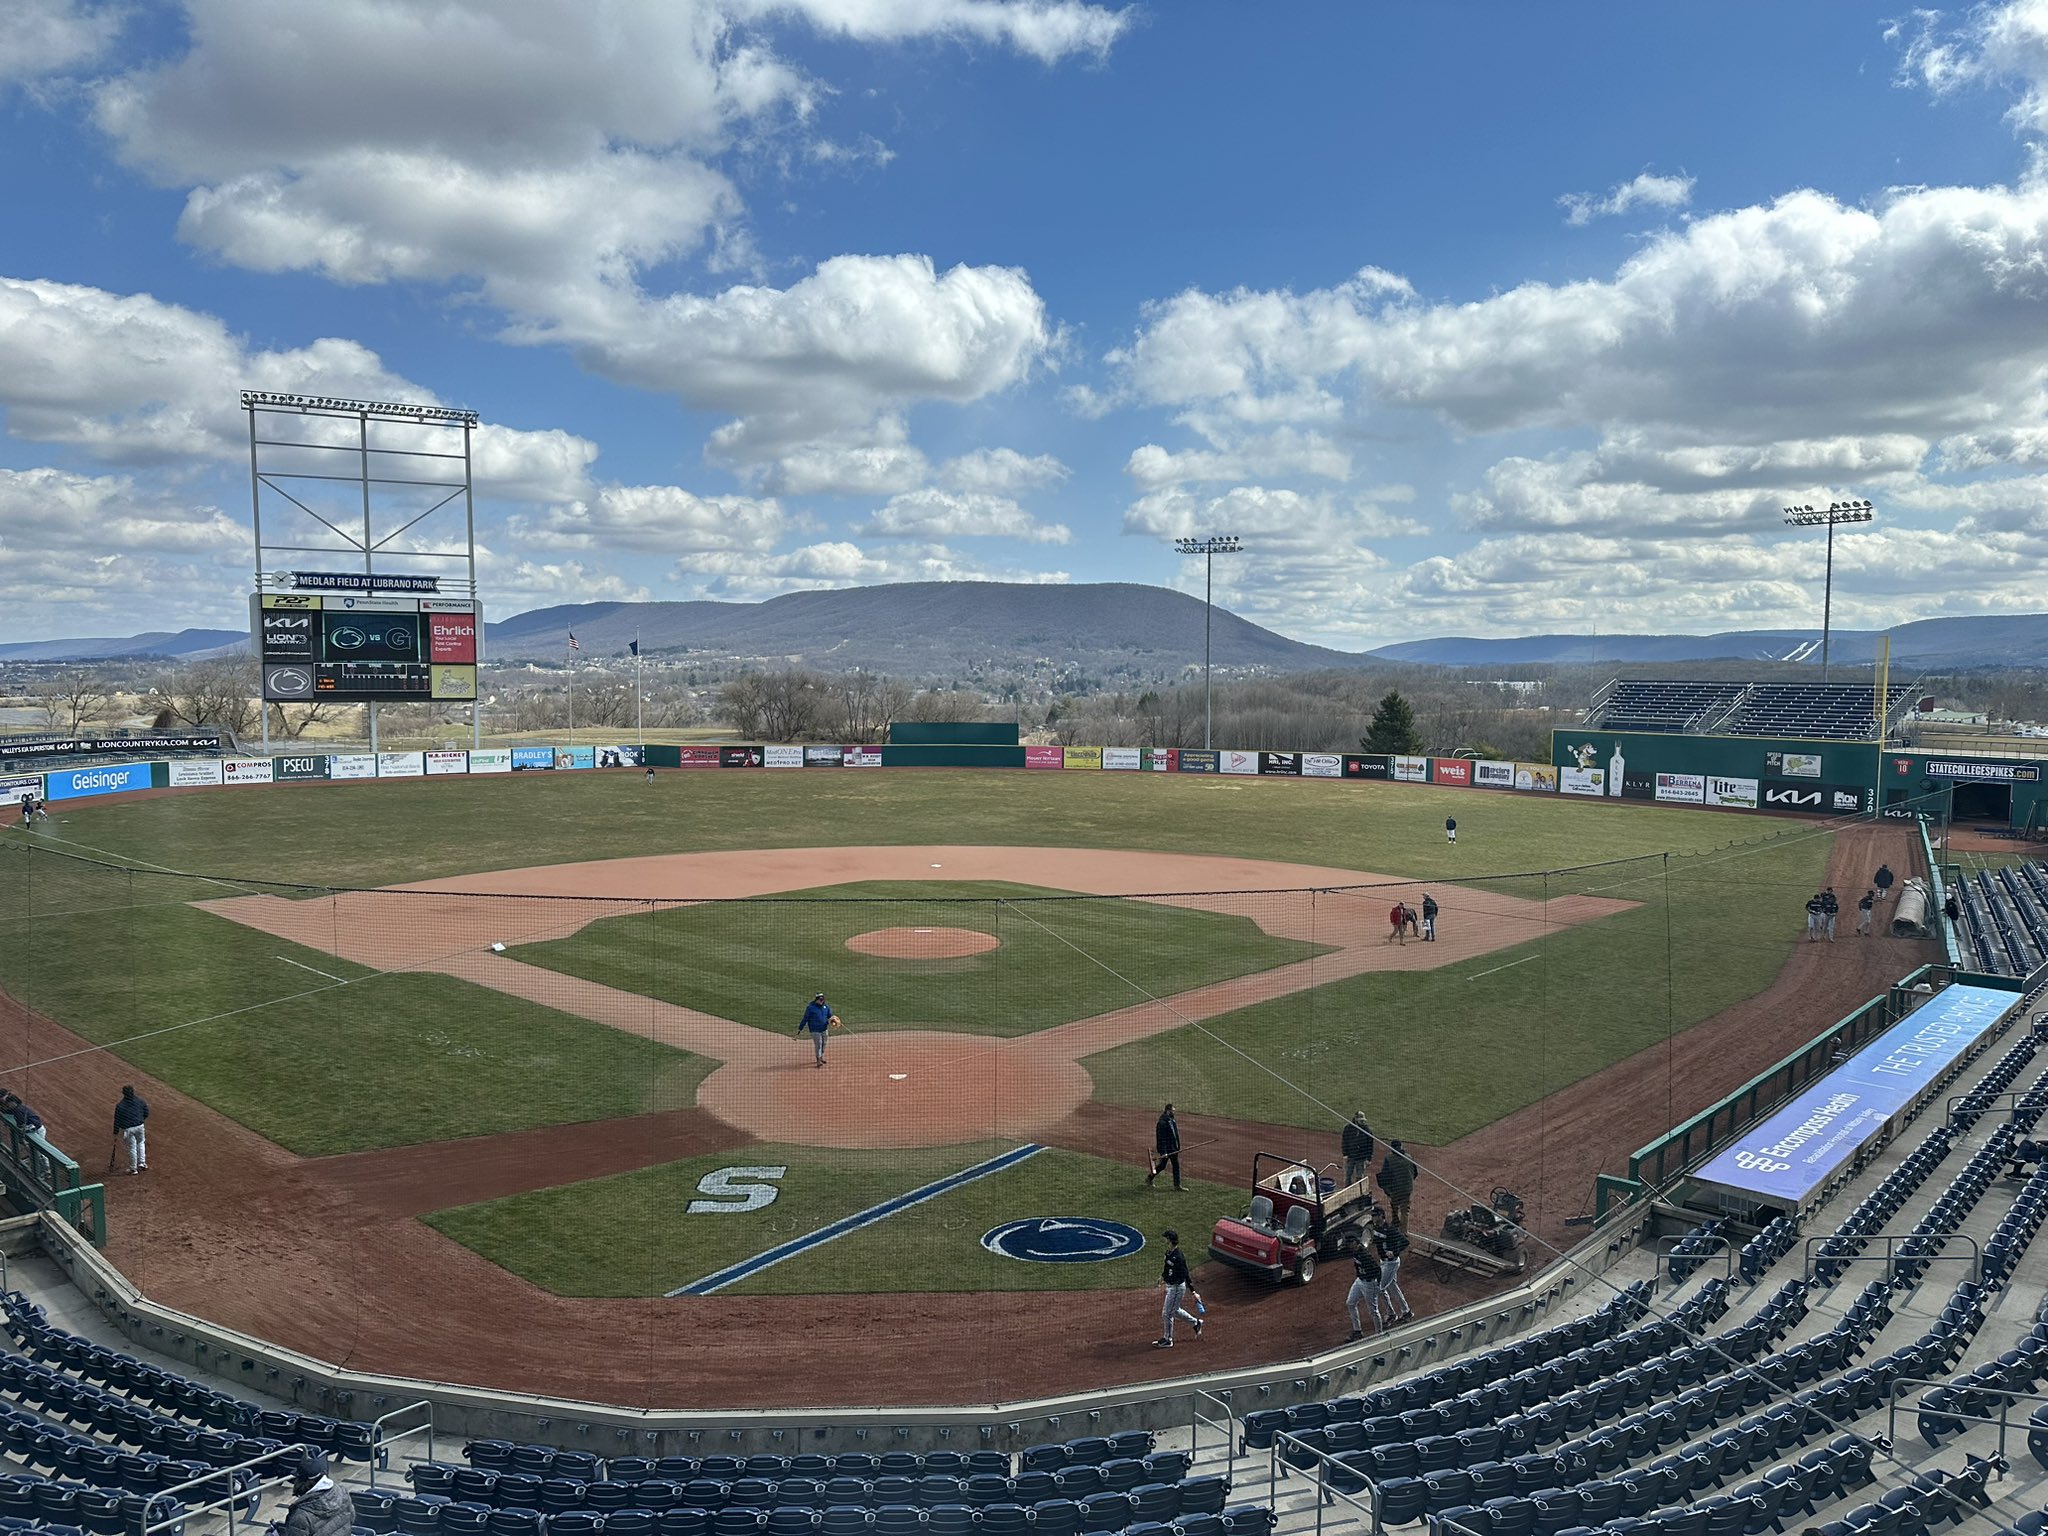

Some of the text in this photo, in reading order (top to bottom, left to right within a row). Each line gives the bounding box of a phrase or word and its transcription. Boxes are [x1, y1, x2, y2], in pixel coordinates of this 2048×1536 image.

[299, 576, 434, 589] MEDLAR FIELD AT LUBRANO PARK
[275, 596, 310, 604] P2P
[264, 617, 309, 628] KIA
[433, 625, 474, 636] Ehrlich
[97, 739, 189, 749] LIONCOUNTRYKIA.COM
[513, 751, 552, 760] BRADLEY'S
[236, 761, 272, 769] COMPROS
[283, 757, 314, 773] PSECU
[1440, 765, 1465, 776] weis
[1899, 764, 1907, 773] 10
[1929, 763, 2036, 779] STATECOLLEGESPIKES.com
[72, 771, 130, 790] Geisinger
[227, 773, 271, 781] 866-266-7767
[1668, 775, 1702, 787] BERRENA
[1660, 789, 1699, 797] 814-643-2645
[1713, 780, 1737, 796] Lite
[1766, 788, 1822, 806] KIA
[1867, 788, 1875, 813] 320
[1884, 809, 1912, 819] KIA
[1896, 1021, 1962, 1058] TRUSTED
[1871, 1055, 1922, 1076] THE
[1759, 1092, 1861, 1158] Encompass Health
